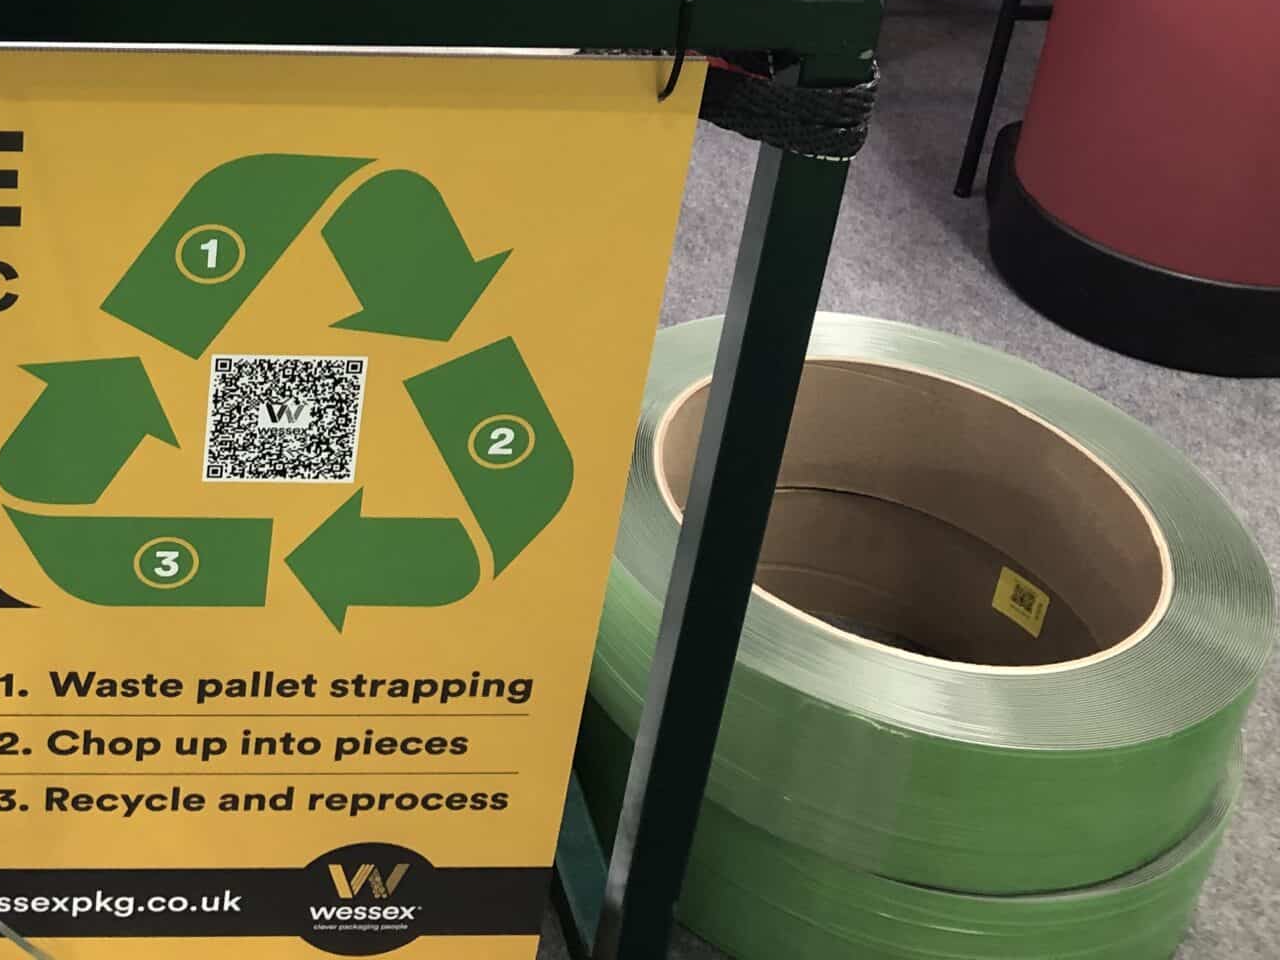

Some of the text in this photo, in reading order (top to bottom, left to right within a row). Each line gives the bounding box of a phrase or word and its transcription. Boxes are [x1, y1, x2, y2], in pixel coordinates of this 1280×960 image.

[199, 238, 219, 269] 1
[487, 427, 516, 456] 2
[153, 550, 180, 577] 3
[49, 671, 183, 698] Waste
[197, 671, 317, 704] pallet
[329, 671, 534, 704] strapping
[47, 729, 161, 762] Chop
[175, 737, 228, 762] up
[241, 729, 322, 756] into
[334, 729, 469, 762] pieces
[45, 786, 206, 817] Recycle
[218, 786, 295, 812] and
[308, 791, 509, 817] reprocess
[309, 906, 417, 921] wessex
